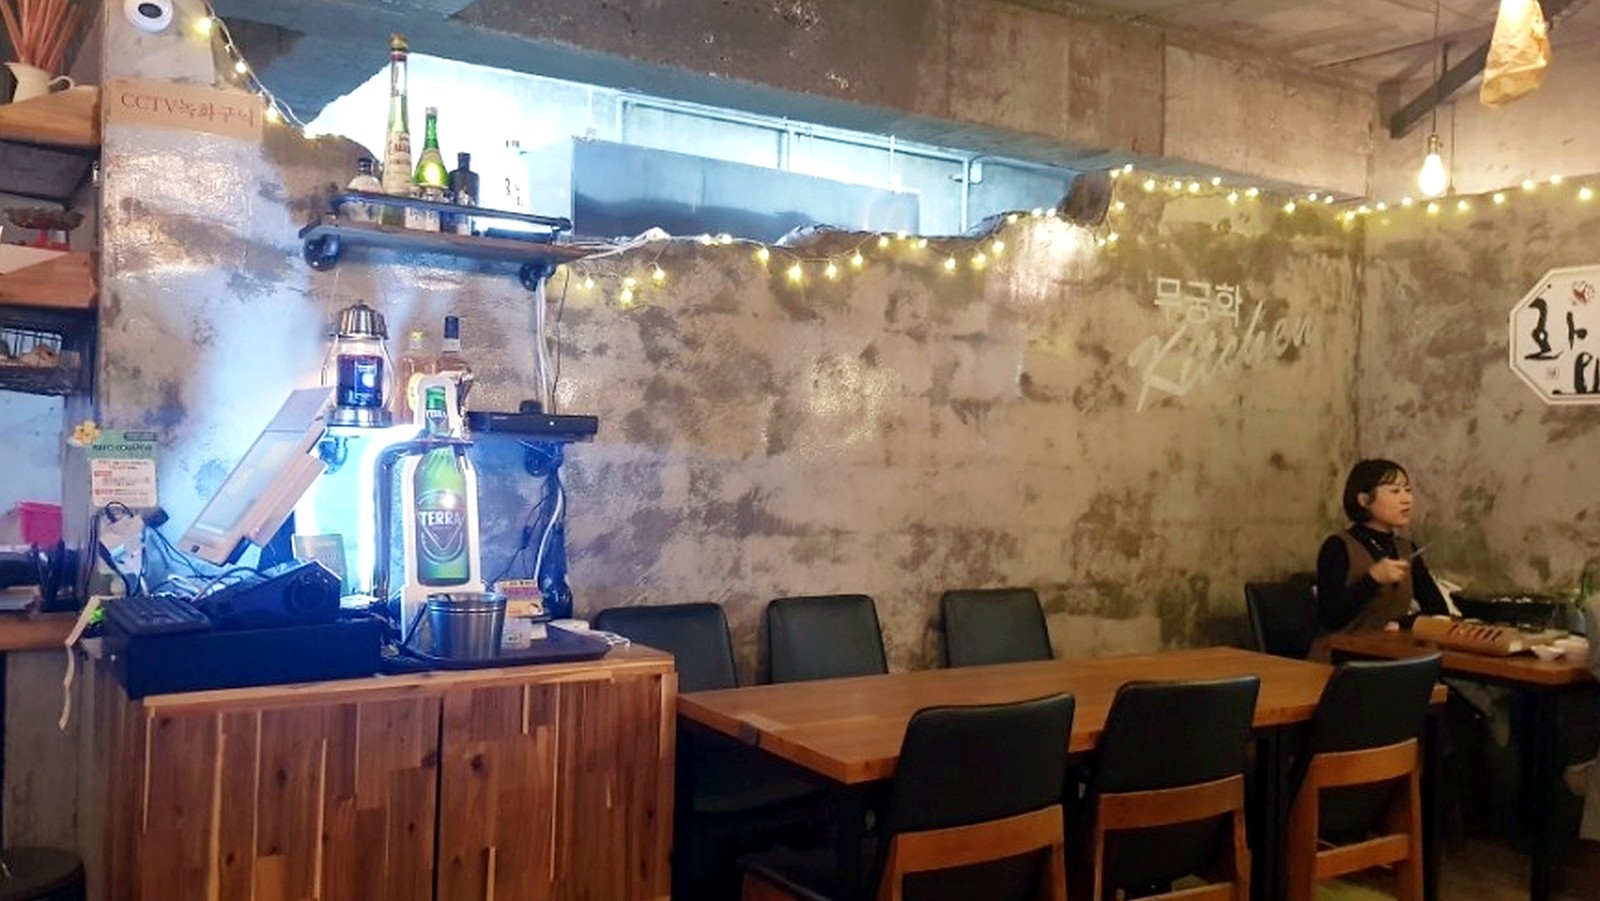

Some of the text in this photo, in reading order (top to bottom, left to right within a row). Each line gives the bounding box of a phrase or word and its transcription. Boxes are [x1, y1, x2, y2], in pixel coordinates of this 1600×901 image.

[1154, 277, 1243, 327] 무궁화
[1127, 300, 1313, 412] Kitchen
[418, 510, 464, 526] TERRA
